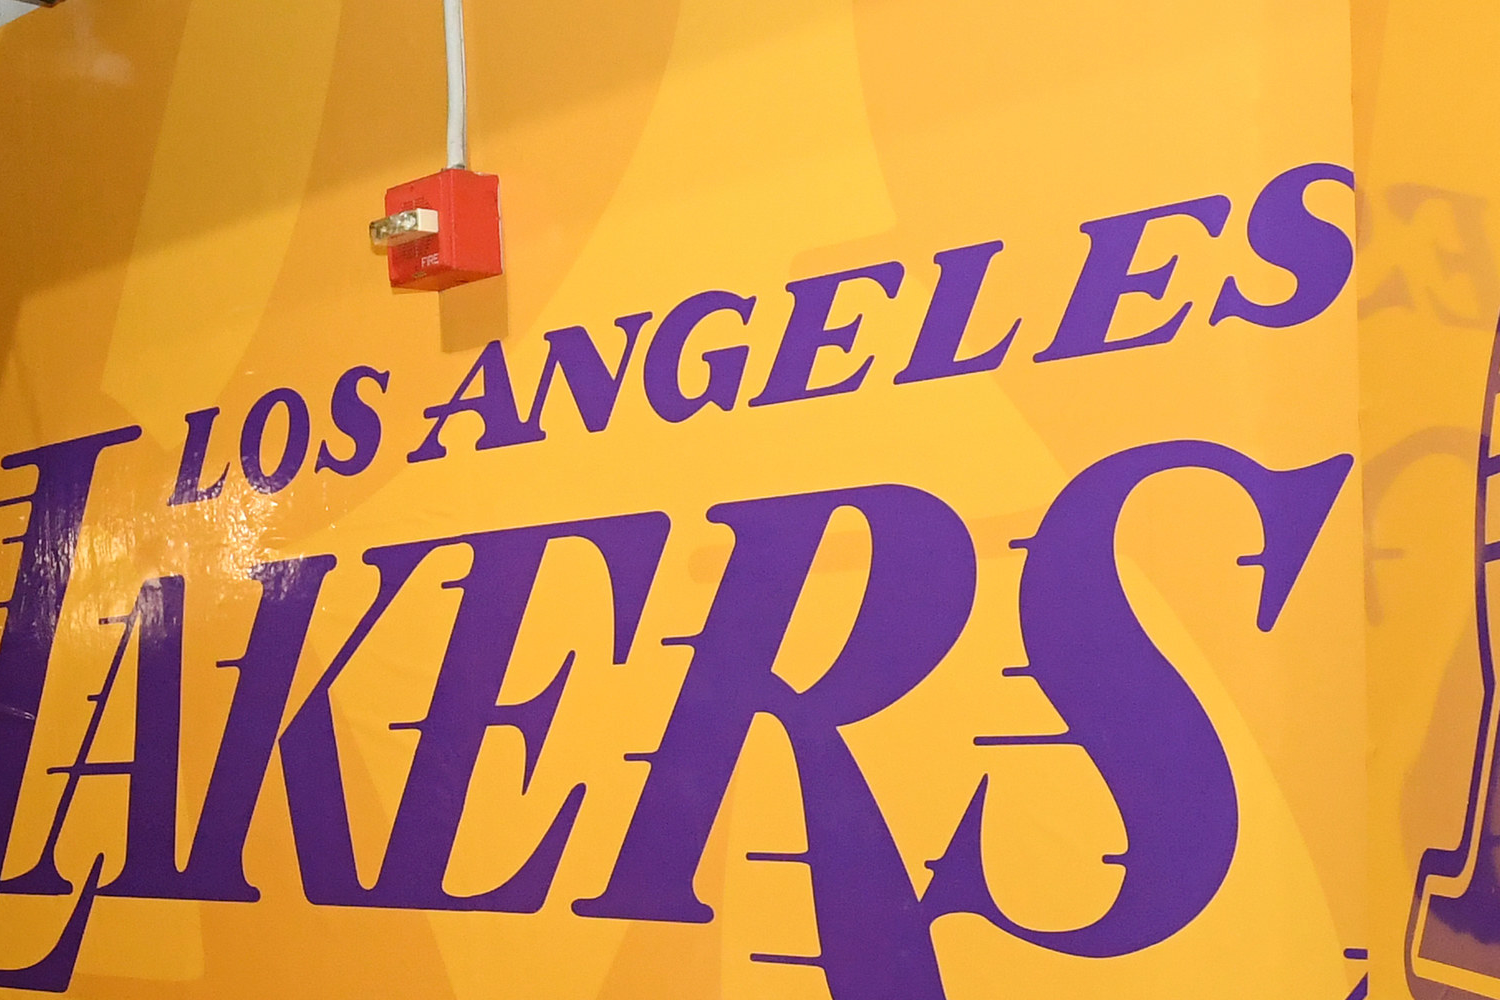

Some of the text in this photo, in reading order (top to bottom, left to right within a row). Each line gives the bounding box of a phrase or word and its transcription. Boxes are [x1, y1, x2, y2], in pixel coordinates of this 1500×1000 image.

[168, 366, 389, 507] LOS
[408, 163, 1354, 463] ANGELES
[421, 252, 439, 268] FIRE
